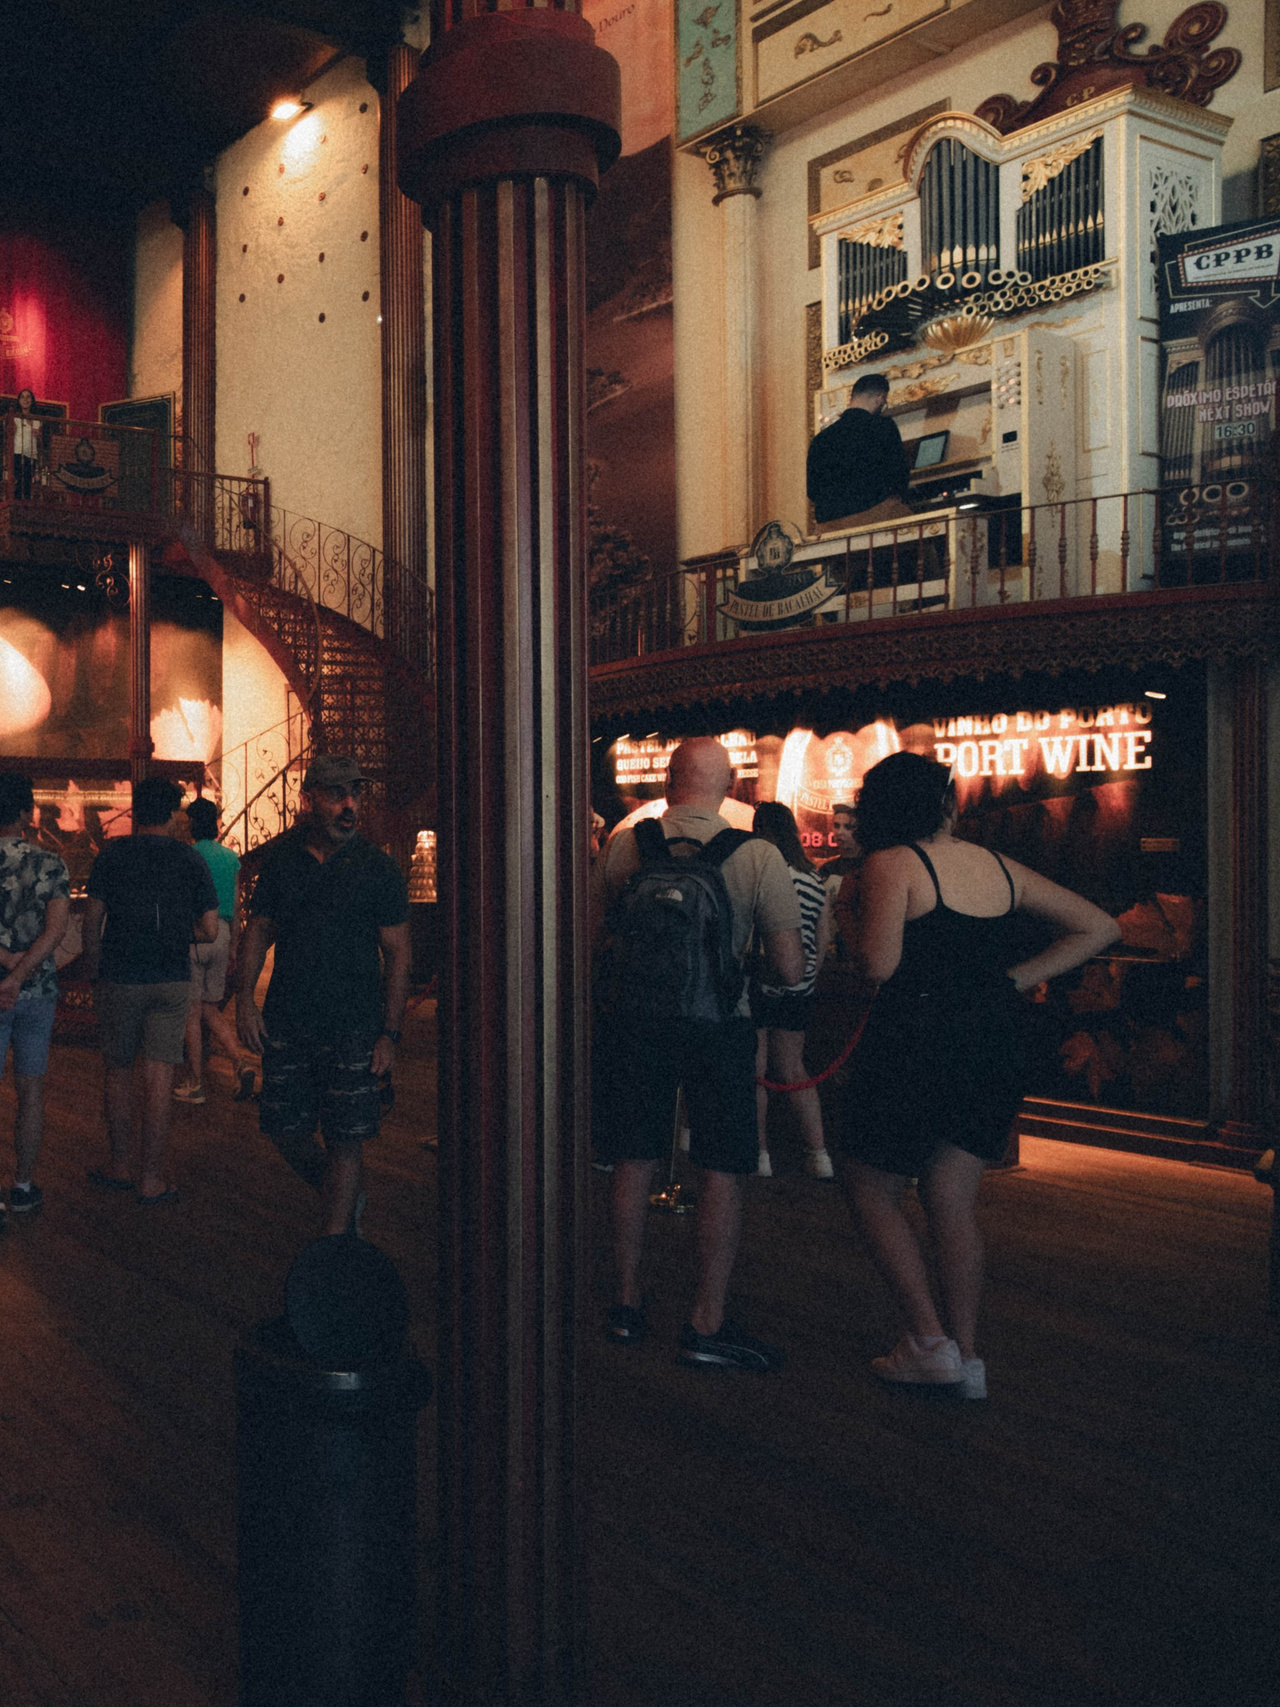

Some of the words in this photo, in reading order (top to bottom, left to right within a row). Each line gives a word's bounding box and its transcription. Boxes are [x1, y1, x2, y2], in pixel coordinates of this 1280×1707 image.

[1194, 244, 1273, 270] CPPB
[1200, 405, 1230, 422] NEXT
[1236, 400, 1271, 418] SHOW
[1217, 422, 1255, 438] 16:30
[728, 600, 760, 618] PASTEL
[763, 603, 774, 618] DE
[777, 586, 824, 616] BACALHAU
[933, 713, 1008, 738] VINHO
[1016, 710, 1051, 732] DO
[1060, 702, 1153, 729] PORTO
[616, 738, 663, 755] PASTEL
[934, 737, 1029, 778] PORT
[1038, 730, 1153, 775] WINE
[616, 757, 651, 771] QUEIJO
